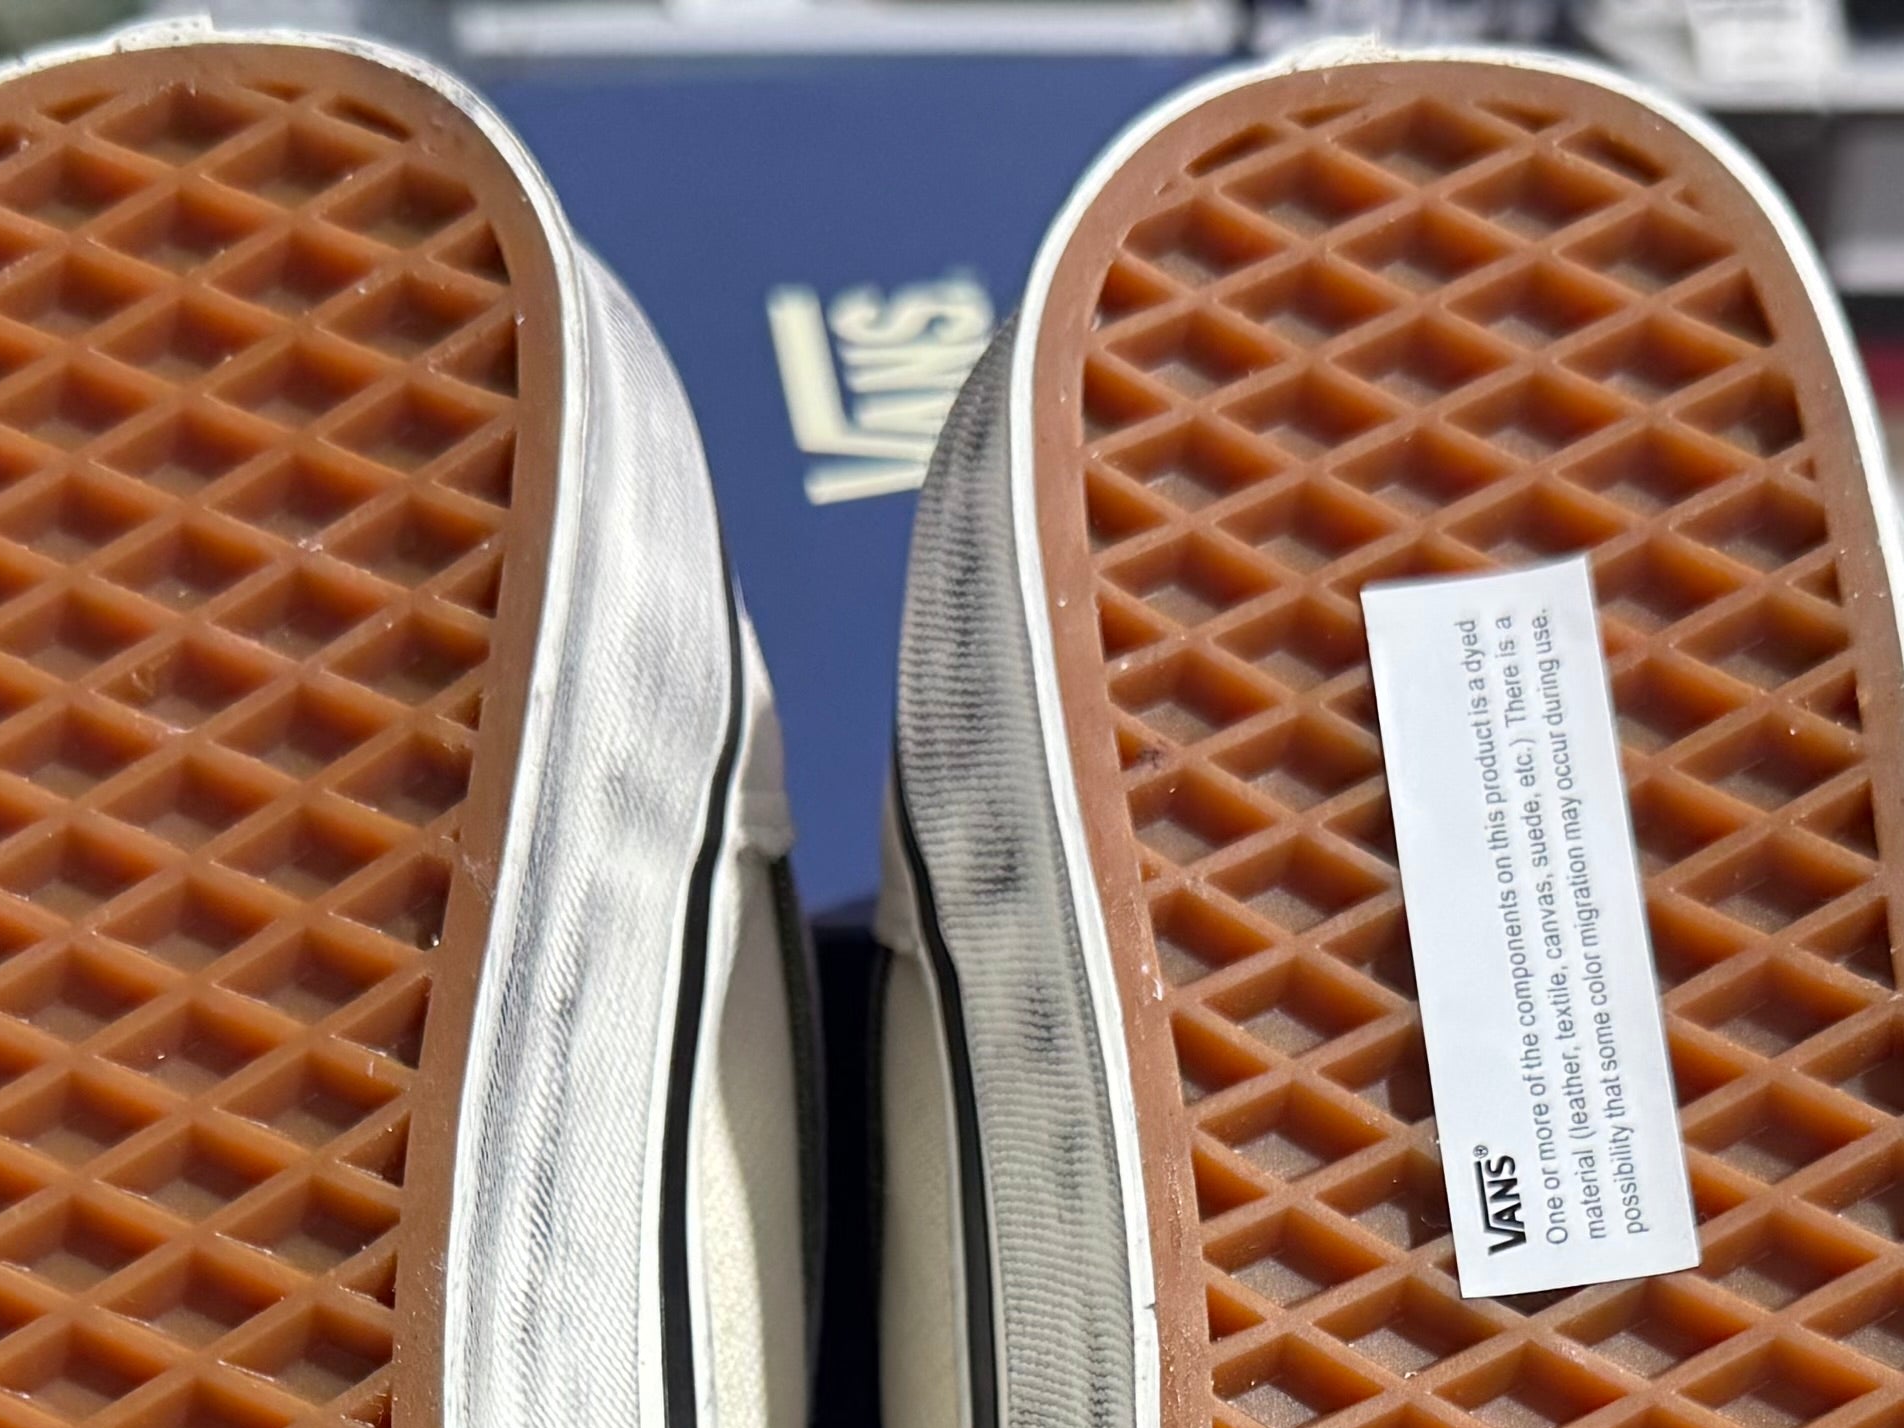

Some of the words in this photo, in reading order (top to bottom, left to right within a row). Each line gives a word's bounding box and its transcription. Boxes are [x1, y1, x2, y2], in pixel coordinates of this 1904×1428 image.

[1454, 619, 1486, 673] dyed
[1495, 614, 1512, 630] a
[1531, 608, 1553, 655] use.
[1495, 639, 1516, 659] is
[1467, 695, 1489, 717] is
[1468, 676, 1485, 691] a
[1503, 664, 1526, 728] There
[1536, 658, 1563, 726] during
[1471, 719, 1508, 805] product
[1508, 737, 1536, 788] etc.)
[1549, 731, 1574, 791] occur
[1484, 806, 1511, 851] this
[1520, 791, 1550, 867] suede,
[1561, 794, 1584, 841] may
[1495, 854, 1514, 883] on
[1535, 874, 1562, 960] canvas,
[1565, 847, 1601, 948] migration
[1497, 889, 1535, 1027] components
[1580, 953, 1609, 1006] color
[1546, 966, 1577, 1041] textile,
[1518, 1032, 1542, 1071] the
[1592, 1011, 1619, 1072] some
[1523, 1073, 1547, 1097] of
[1559, 1046, 1597, 1140] (leather,
[1603, 1074, 1625, 1121] that
[1532, 1102, 1557, 1168] more
[1542, 1168, 1562, 1190] or
[1570, 1150, 1608, 1241] material
[1608, 1124, 1650, 1235] possibility
[1545, 1197, 1569, 1245] One
